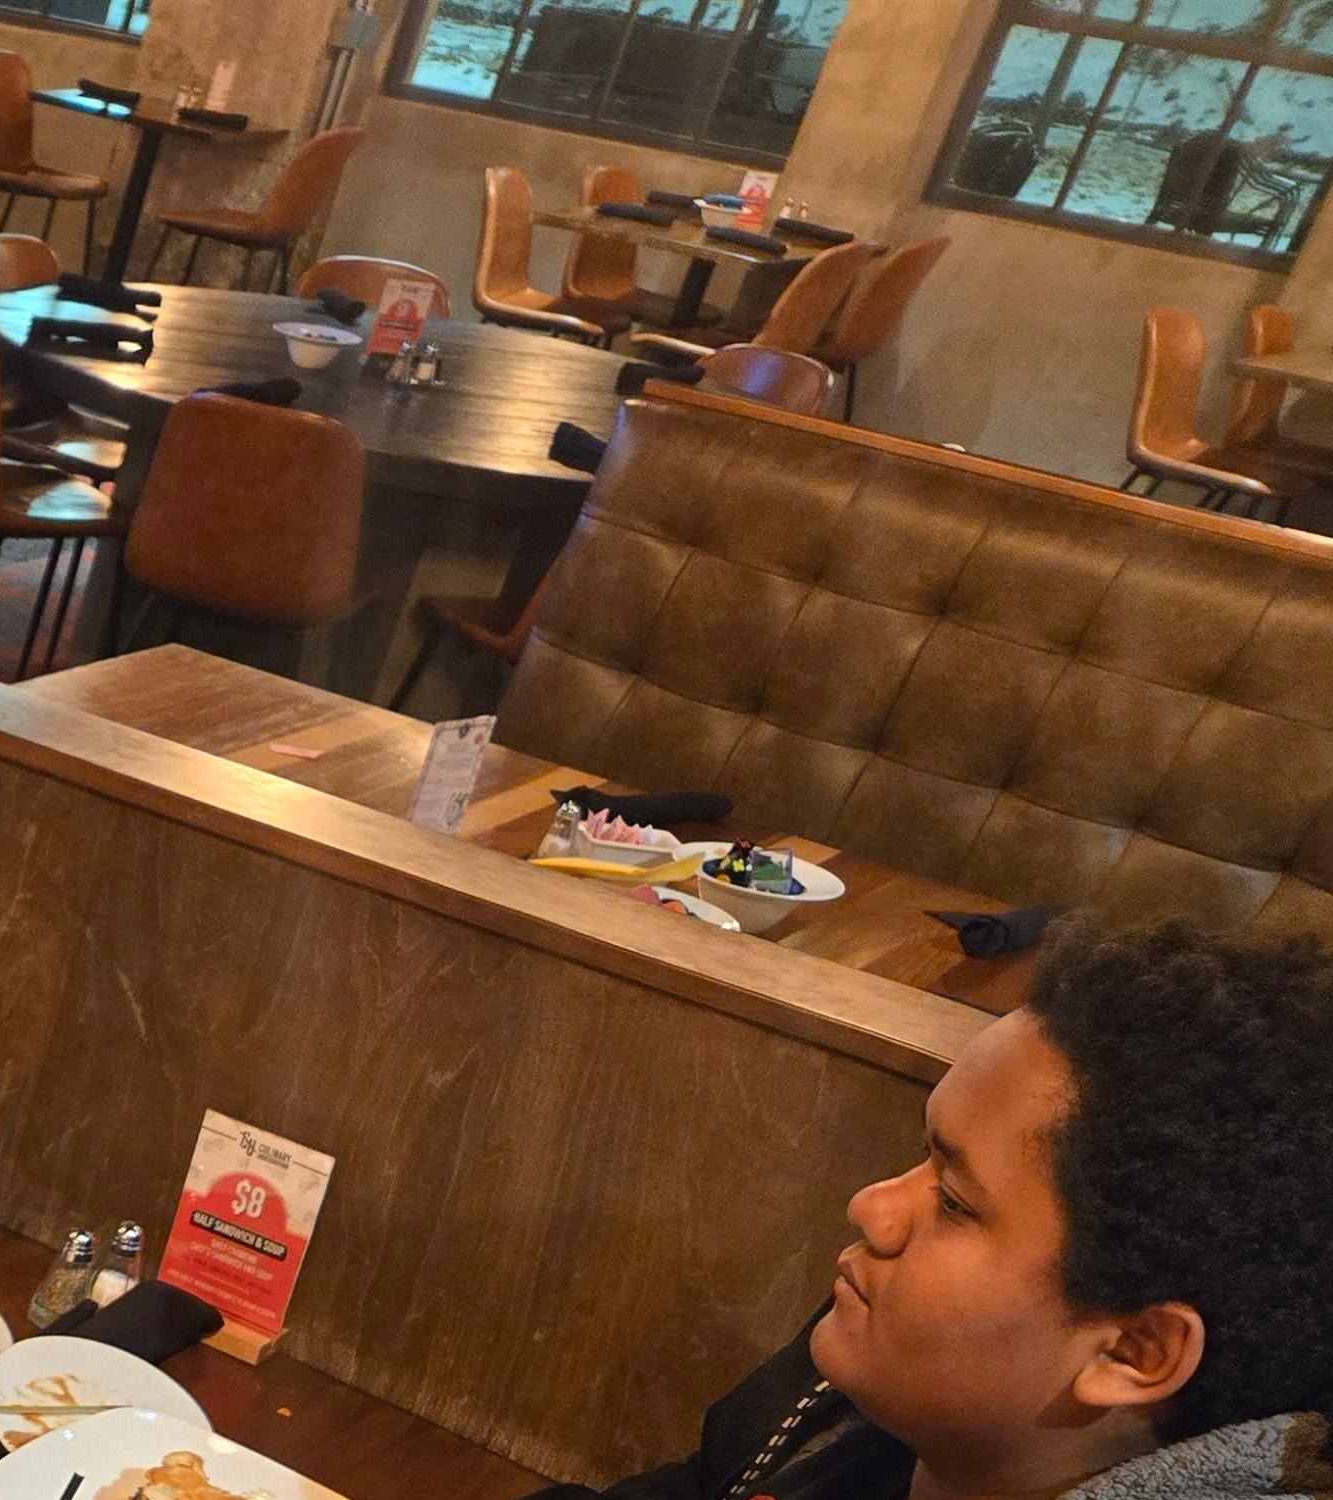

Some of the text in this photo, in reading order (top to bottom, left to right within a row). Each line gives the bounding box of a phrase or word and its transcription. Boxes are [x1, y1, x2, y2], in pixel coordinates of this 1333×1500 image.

[232, 1179, 266, 1218] $8
[193, 1211, 215, 1228] HALF
[213, 1219, 255, 1244] SANDWICH
[262, 1240, 286, 1257] SOUP
